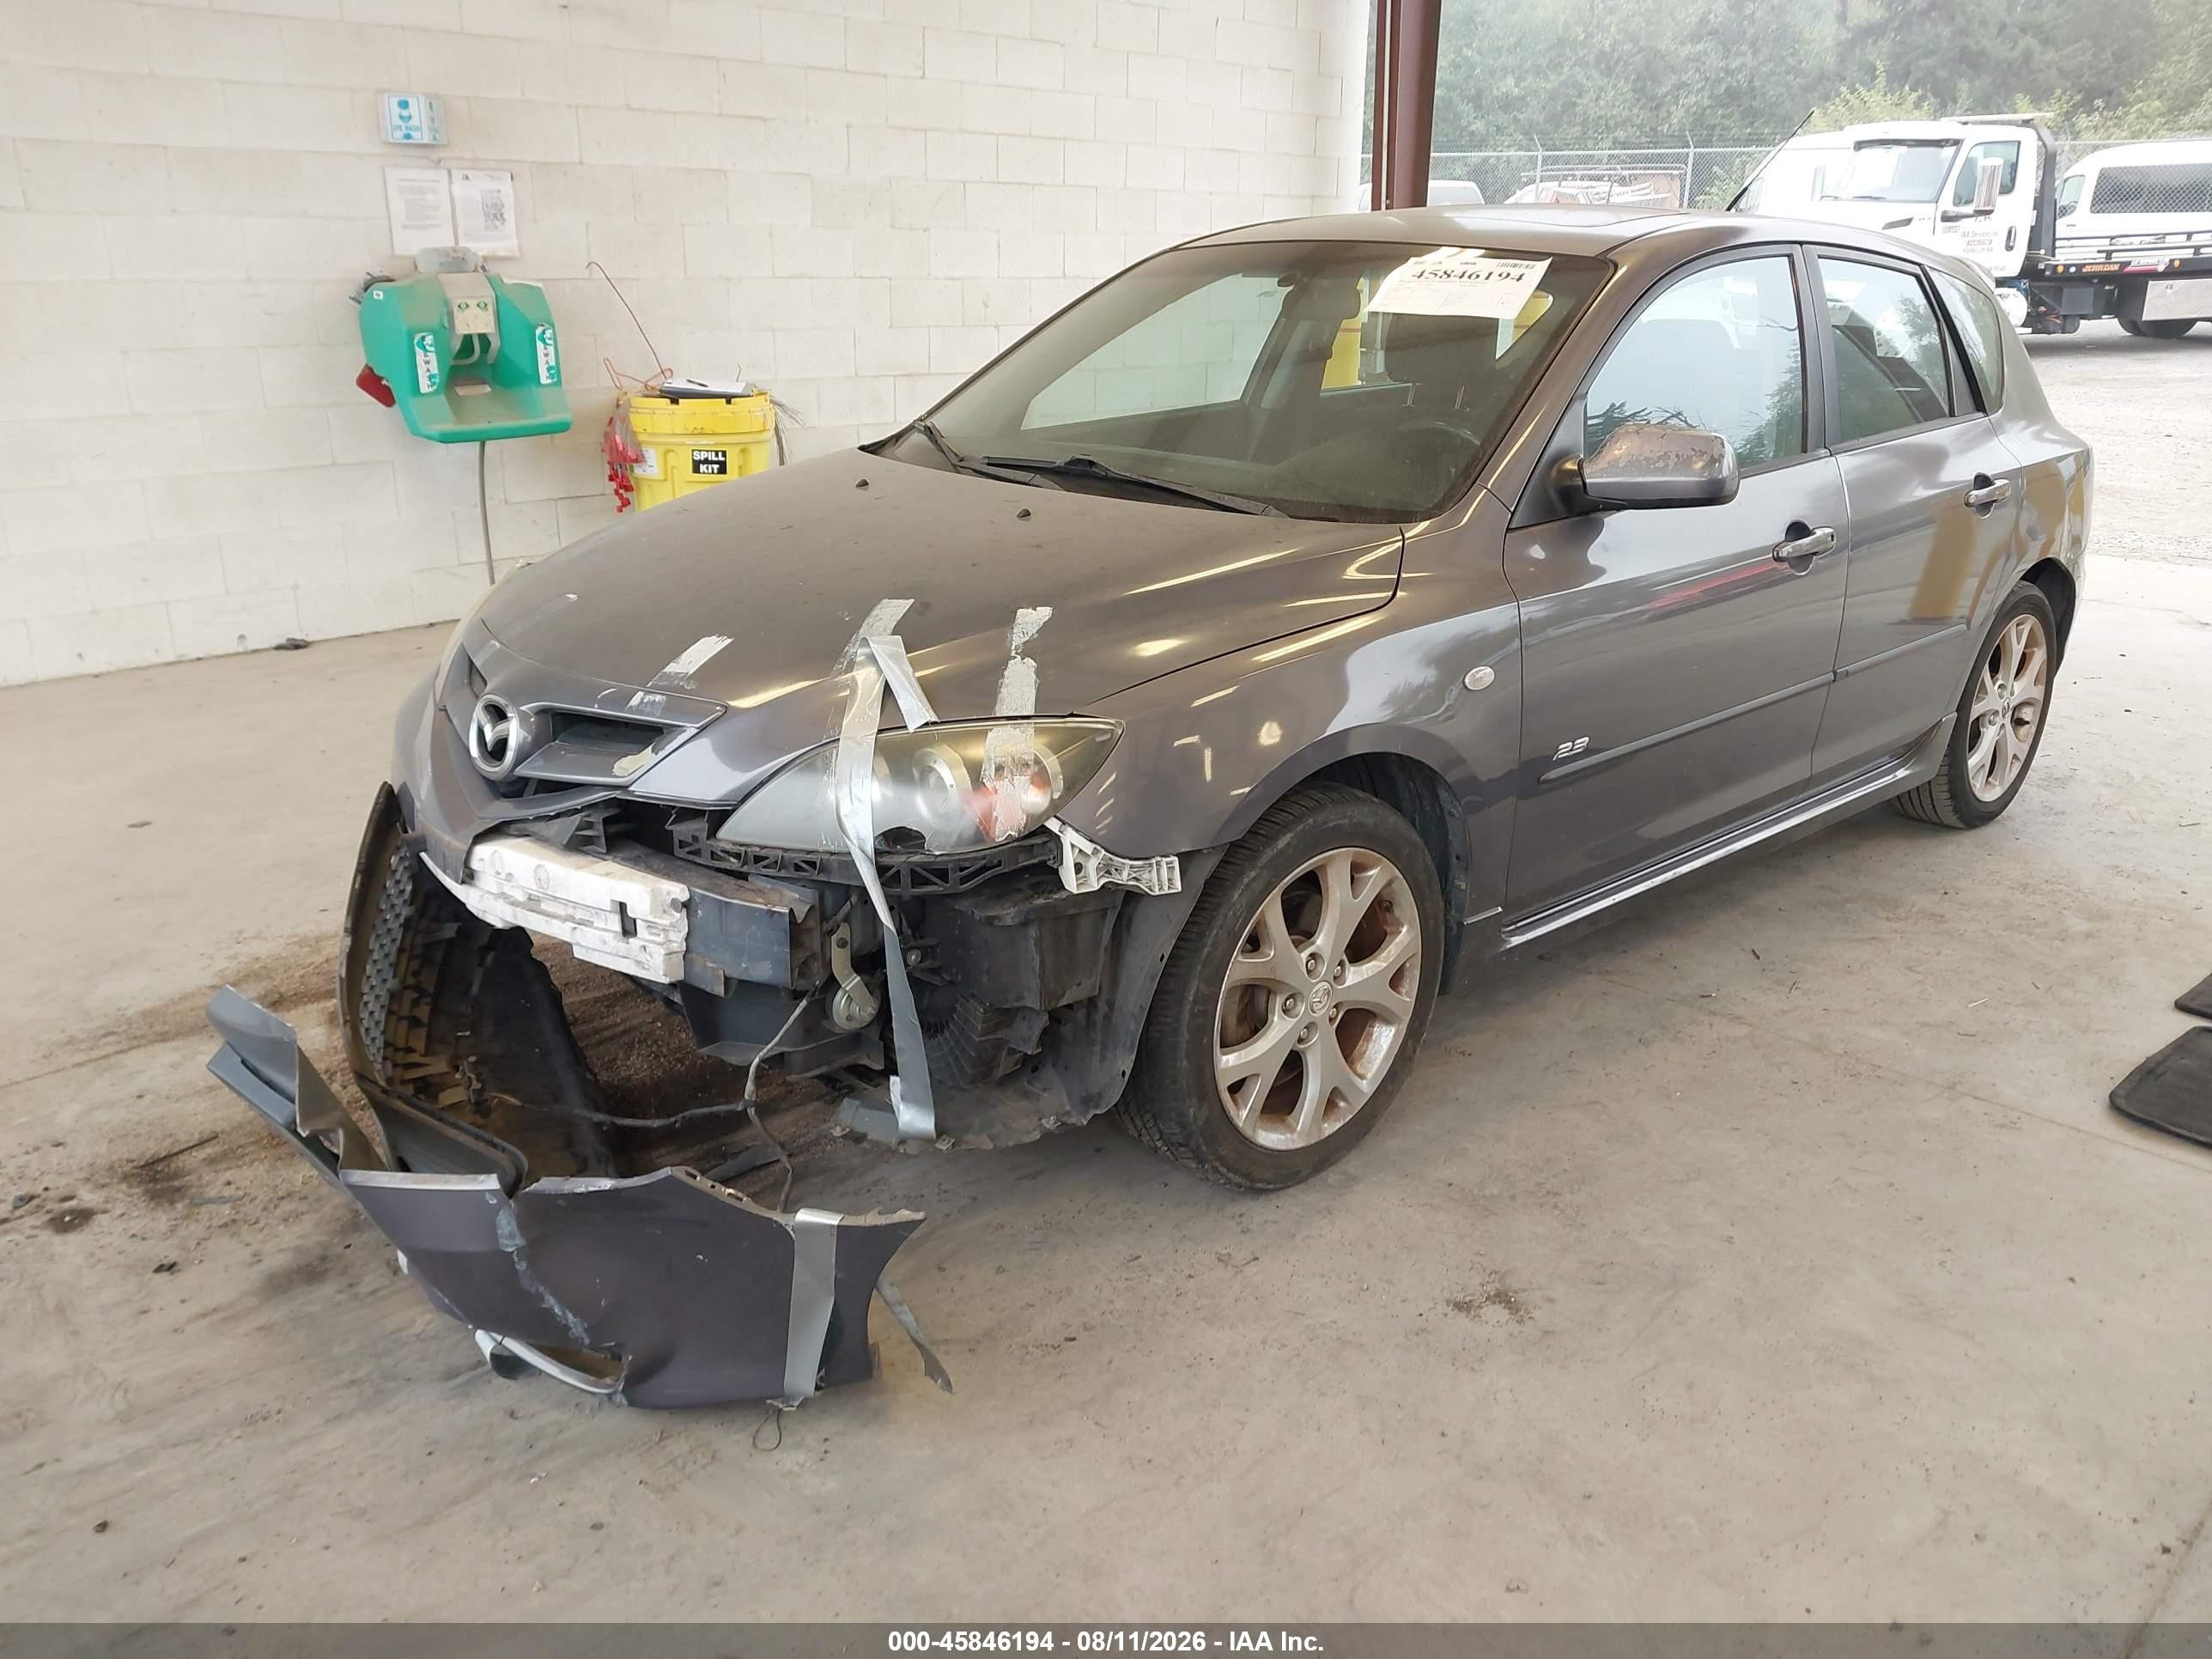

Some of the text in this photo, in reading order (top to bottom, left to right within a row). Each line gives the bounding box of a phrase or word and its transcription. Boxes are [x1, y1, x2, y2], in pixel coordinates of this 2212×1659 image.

[1411, 268, 1526, 282] 45846194
[692, 451, 725, 461] SPILL
[699, 464, 720, 474] KIT
